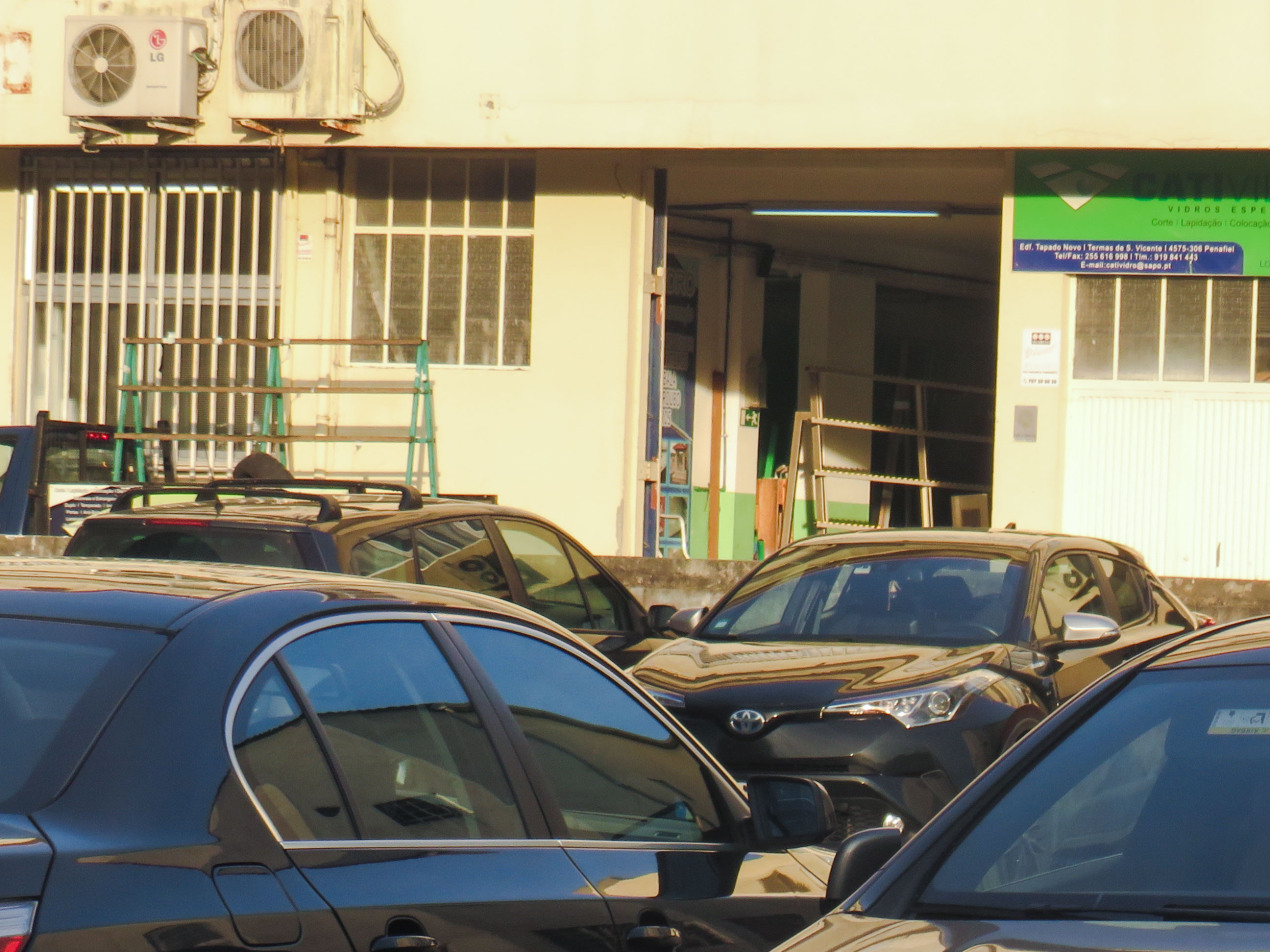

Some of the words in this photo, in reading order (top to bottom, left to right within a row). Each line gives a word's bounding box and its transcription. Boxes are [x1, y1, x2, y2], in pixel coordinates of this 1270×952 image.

[150, 52, 165, 62] LG
[1168, 205, 1220, 213] VIDROS
[1151, 218, 1174, 226] Corte
[1181, 218, 1222, 228] Lapidação
[1036, 243, 1061, 252] Tapado
[1135, 244, 1162, 252] Vicente
[1204, 245, 1235, 253] Penafiel
